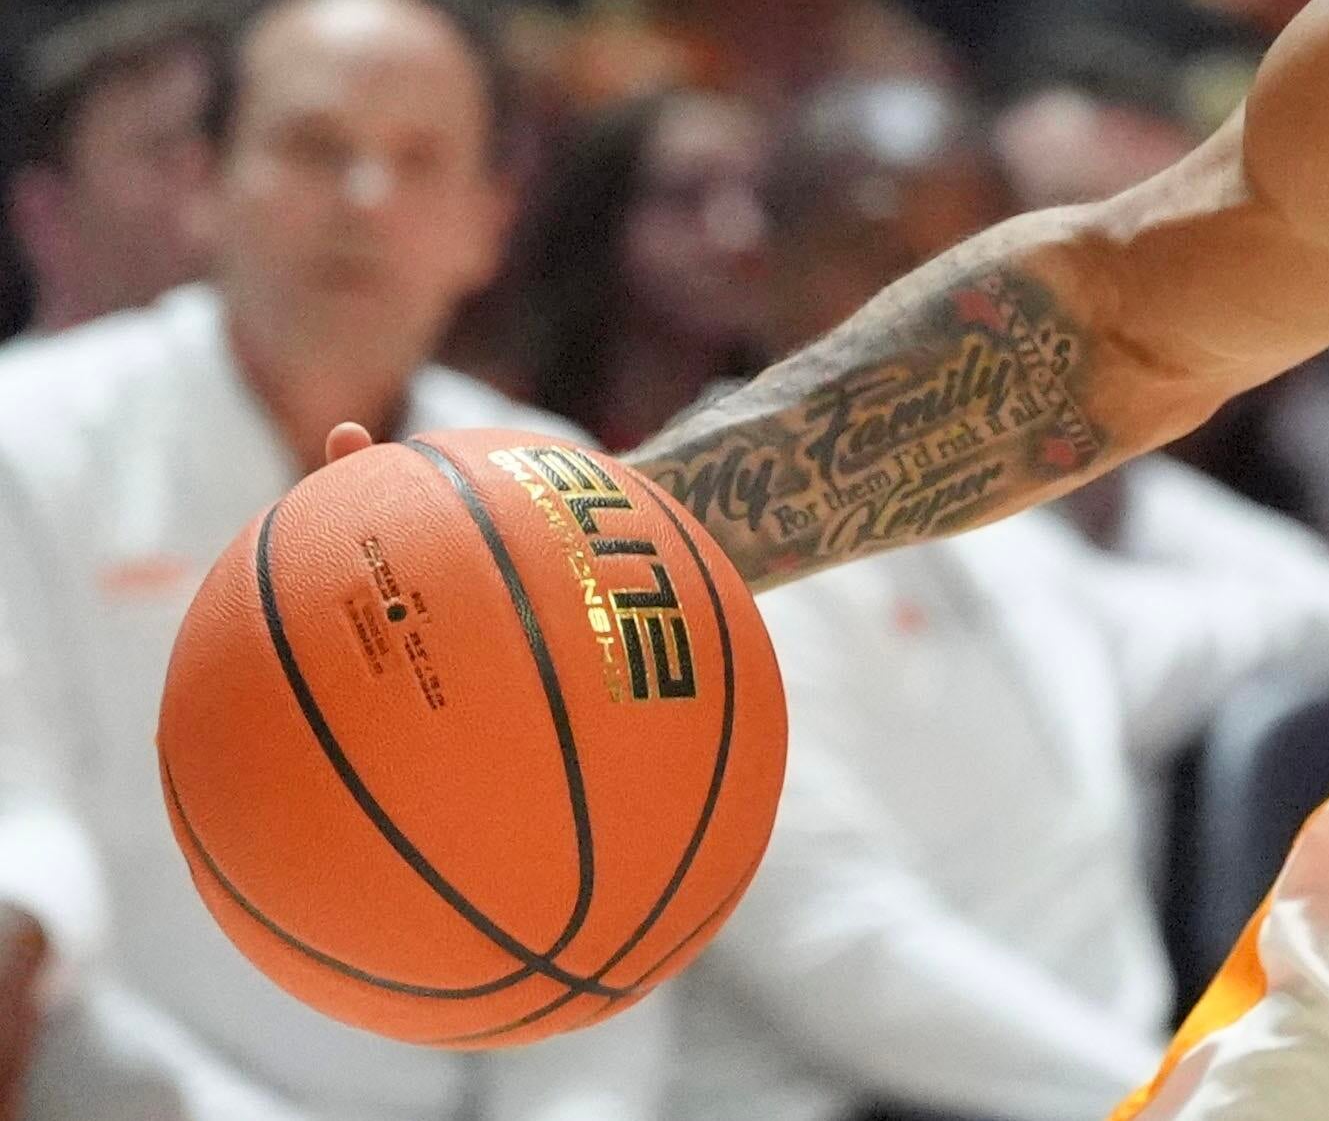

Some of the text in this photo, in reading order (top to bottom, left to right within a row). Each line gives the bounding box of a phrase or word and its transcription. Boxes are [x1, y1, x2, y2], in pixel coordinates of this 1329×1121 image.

[512, 445, 697, 701] ELITE
[771, 500, 819, 540] For
[823, 468, 893, 509] them
